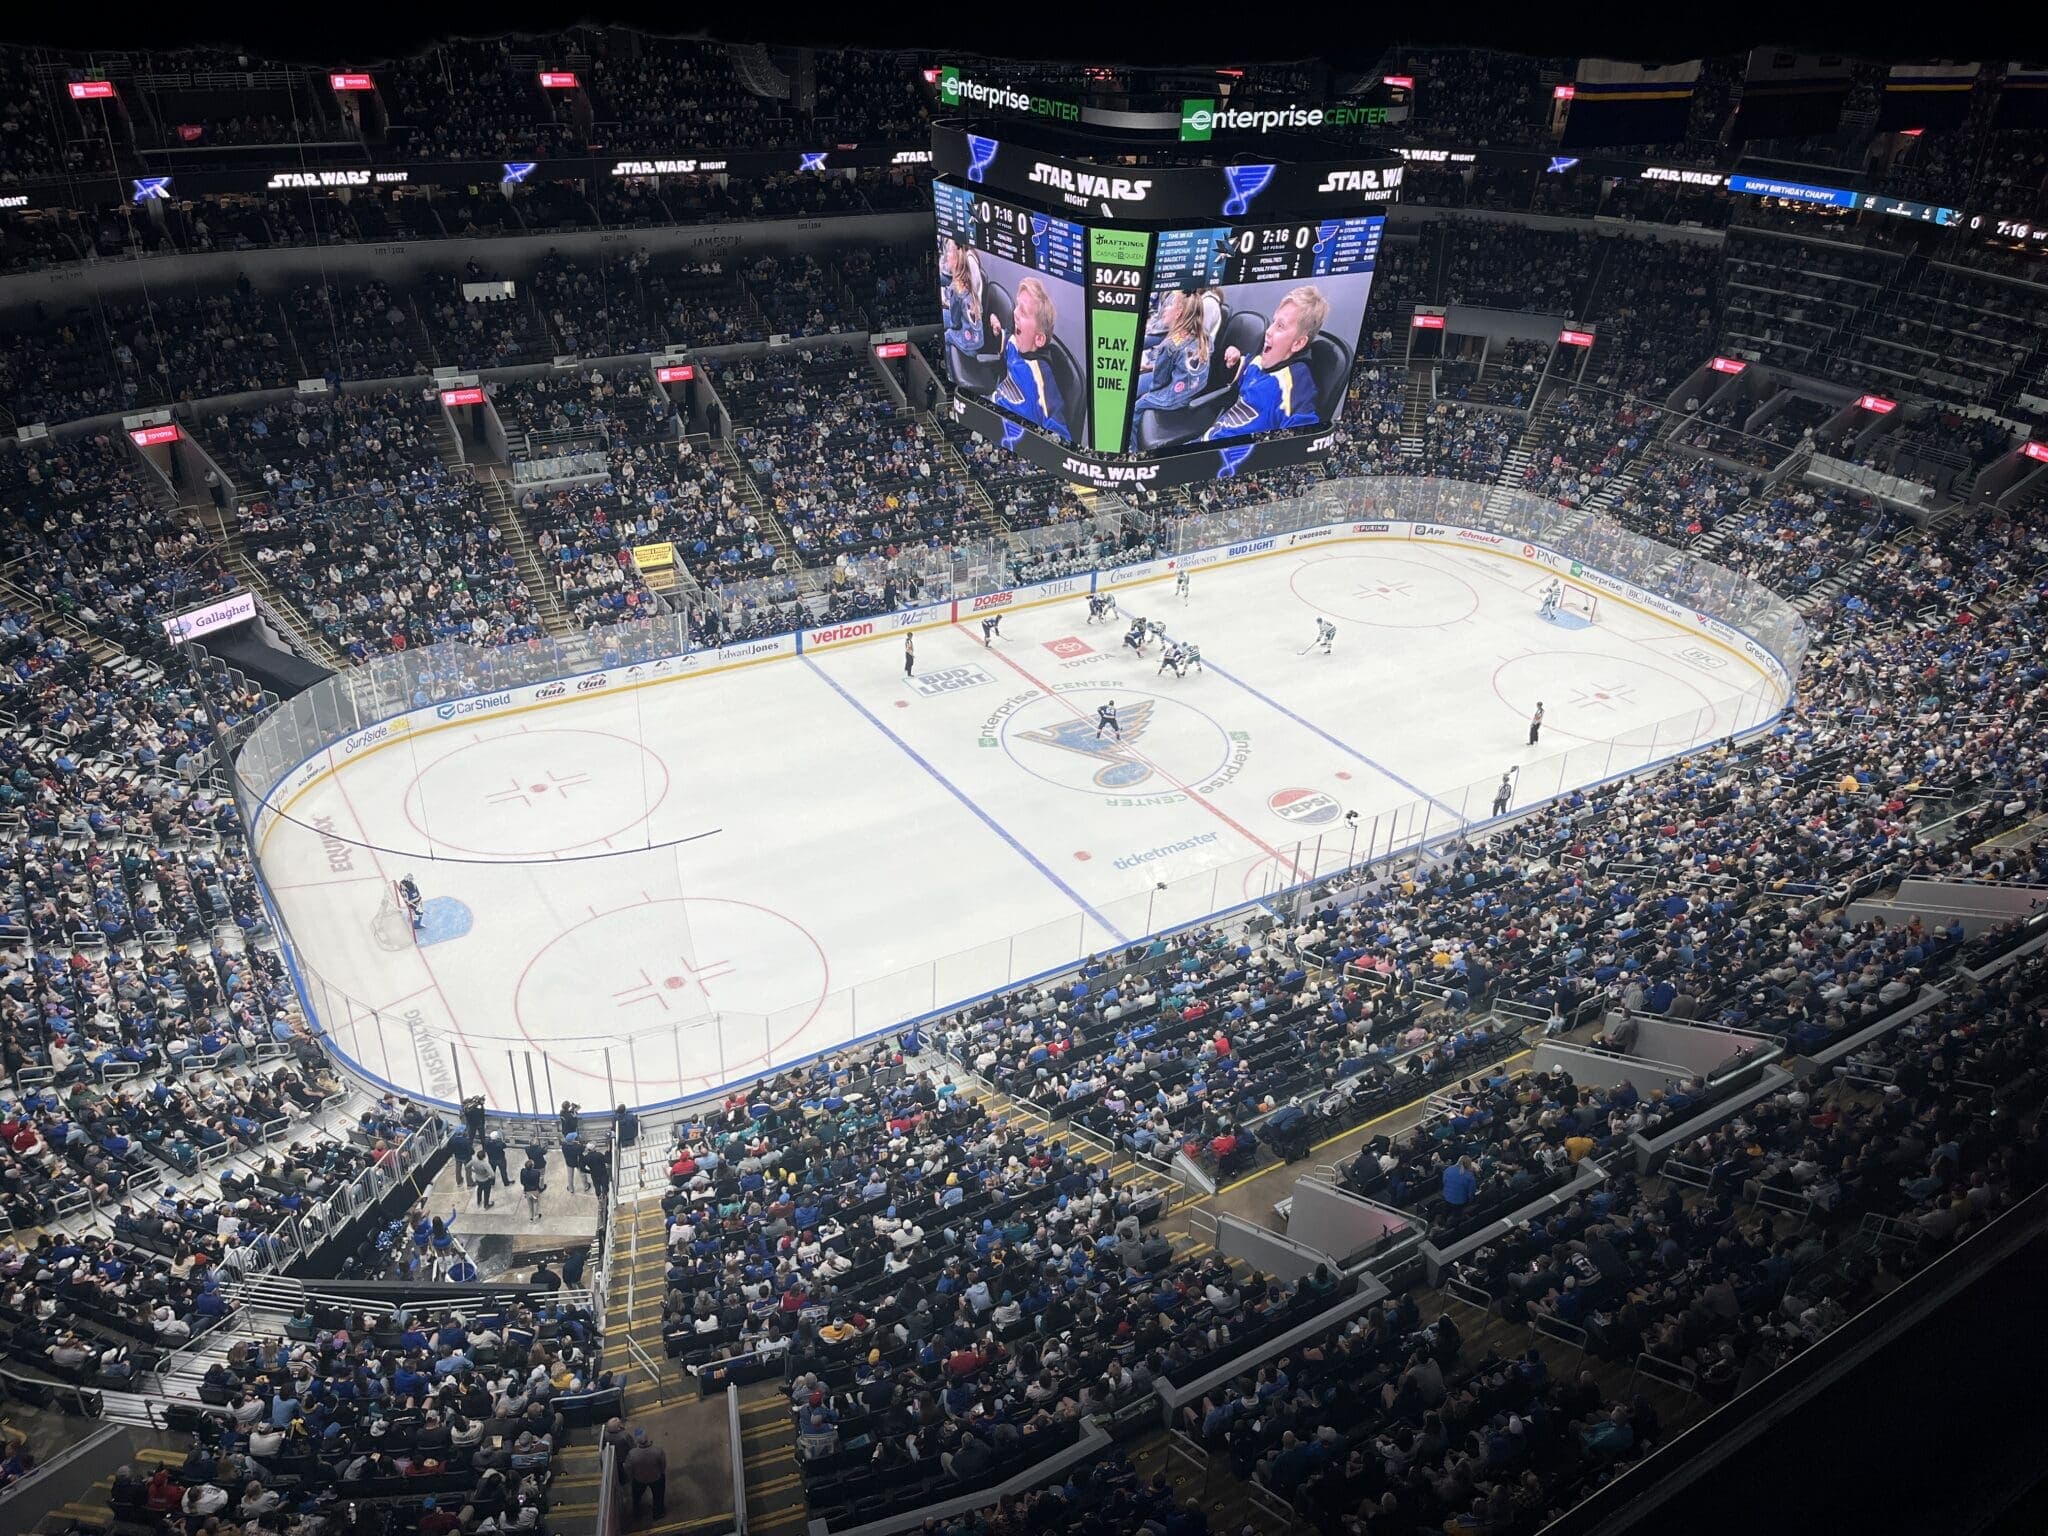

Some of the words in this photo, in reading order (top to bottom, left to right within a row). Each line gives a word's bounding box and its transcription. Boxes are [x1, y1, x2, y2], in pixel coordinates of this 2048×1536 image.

[944, 76, 1030, 111] enterprise
[1029, 97, 1080, 122] CENTER
[1186, 105, 1324, 134] enterprise
[1324, 107, 1389, 126] CENTER
[891, 151, 928, 164] STAR
[1411, 149, 1450, 162] WARS
[1451, 154, 1476, 162] NIGHT
[611, 161, 655, 175] STAR
[655, 160, 697, 173] WARS
[700, 161, 727, 170] NIGHT
[1641, 167, 1682, 184] STAR
[1681, 171, 1723, 186] WARS
[267, 173, 321, 188] STAR
[320, 170, 371, 185] WARS
[376, 172, 408, 182] NIGHT
[1028, 162, 1076, 192] STAR
[1077, 173, 1152, 201] WARS
[1318, 170, 1380, 192] STAR
[1064, 192, 1089, 208] NIGHT
[1364, 190, 1392, 201] NIGHT
[1745, 181, 1769, 192] HAPPY
[1769, 185, 1804, 197] BIRTHDAY
[1805, 189, 1836, 201] CHAPPY
[0, 196, 28, 207] IGHT
[981, 201, 991, 223] 0
[993, 205, 1013, 222] 7:16
[1018, 213, 1027, 235] 0
[1970, 217, 1980, 229] 0
[1996, 221, 2027, 238] 7:16
[690, 235, 742, 249] JAMESON
[1094, 234, 1145, 248] DRAFTKINGS
[1240, 231, 1255, 254] 0
[1262, 228, 1290, 244] 7:16
[1296, 227, 1309, 249] 0
[1096, 250, 1118, 258] CASINO
[1095, 268, 1141, 287] 50/50
[1097, 290, 1136, 306] $6,071
[1098, 336, 1129, 352] PLAY.
[1097, 357, 1128, 372] STAY.
[1097, 376, 1125, 392] DINE.
[953, 396, 967, 415] RS
[147, 430, 173, 440] TOYOTA
[1307, 433, 1335, 452] STA
[1062, 457, 1105, 480] STAR
[1108, 464, 1160, 481] WARS
[1093, 479, 1120, 489] NIGHT
[1298, 529, 1332, 541] UNDERDOG
[1456, 530, 1504, 545] Schnucks
[1229, 545, 1248, 557] BUD
[1249, 539, 1275, 552] LIGHT
[1176, 556, 1217, 569] COMMUNITY
[1536, 550, 1561, 568] PNC
[1110, 569, 1134, 584] Circa
[1573, 565, 1623, 592] enterprise
[1040, 581, 1074, 596] STIFEL
[974, 591, 1013, 607] DOBBS
[1628, 589, 1642, 603] BJC
[1644, 595, 1683, 618] HealthCare
[195, 601, 251, 628] Gallagher
[811, 622, 874, 645] verizon
[717, 646, 751, 661] Edward
[751, 640, 779, 655] Jones
[1689, 650, 1721, 668] BJC
[1745, 642, 1767, 663] Great
[1059, 652, 1117, 670] TOYOTA
[577, 677, 607, 692] Club
[918, 672, 988, 696] LIGHT
[921, 667, 970, 686] BUD
[535, 685, 566, 700] Club
[456, 694, 511, 715] CarShield
[978, 690, 1040, 748] enterprise
[1051, 680, 1124, 691] CENTER
[345, 726, 388, 754] Surfside
[1198, 731, 1253, 794] enterprise
[1105, 793, 1188, 807] CENTER
[1281, 795, 1328, 818] PEPSI
[1113, 830, 1220, 871] ticketmaster
